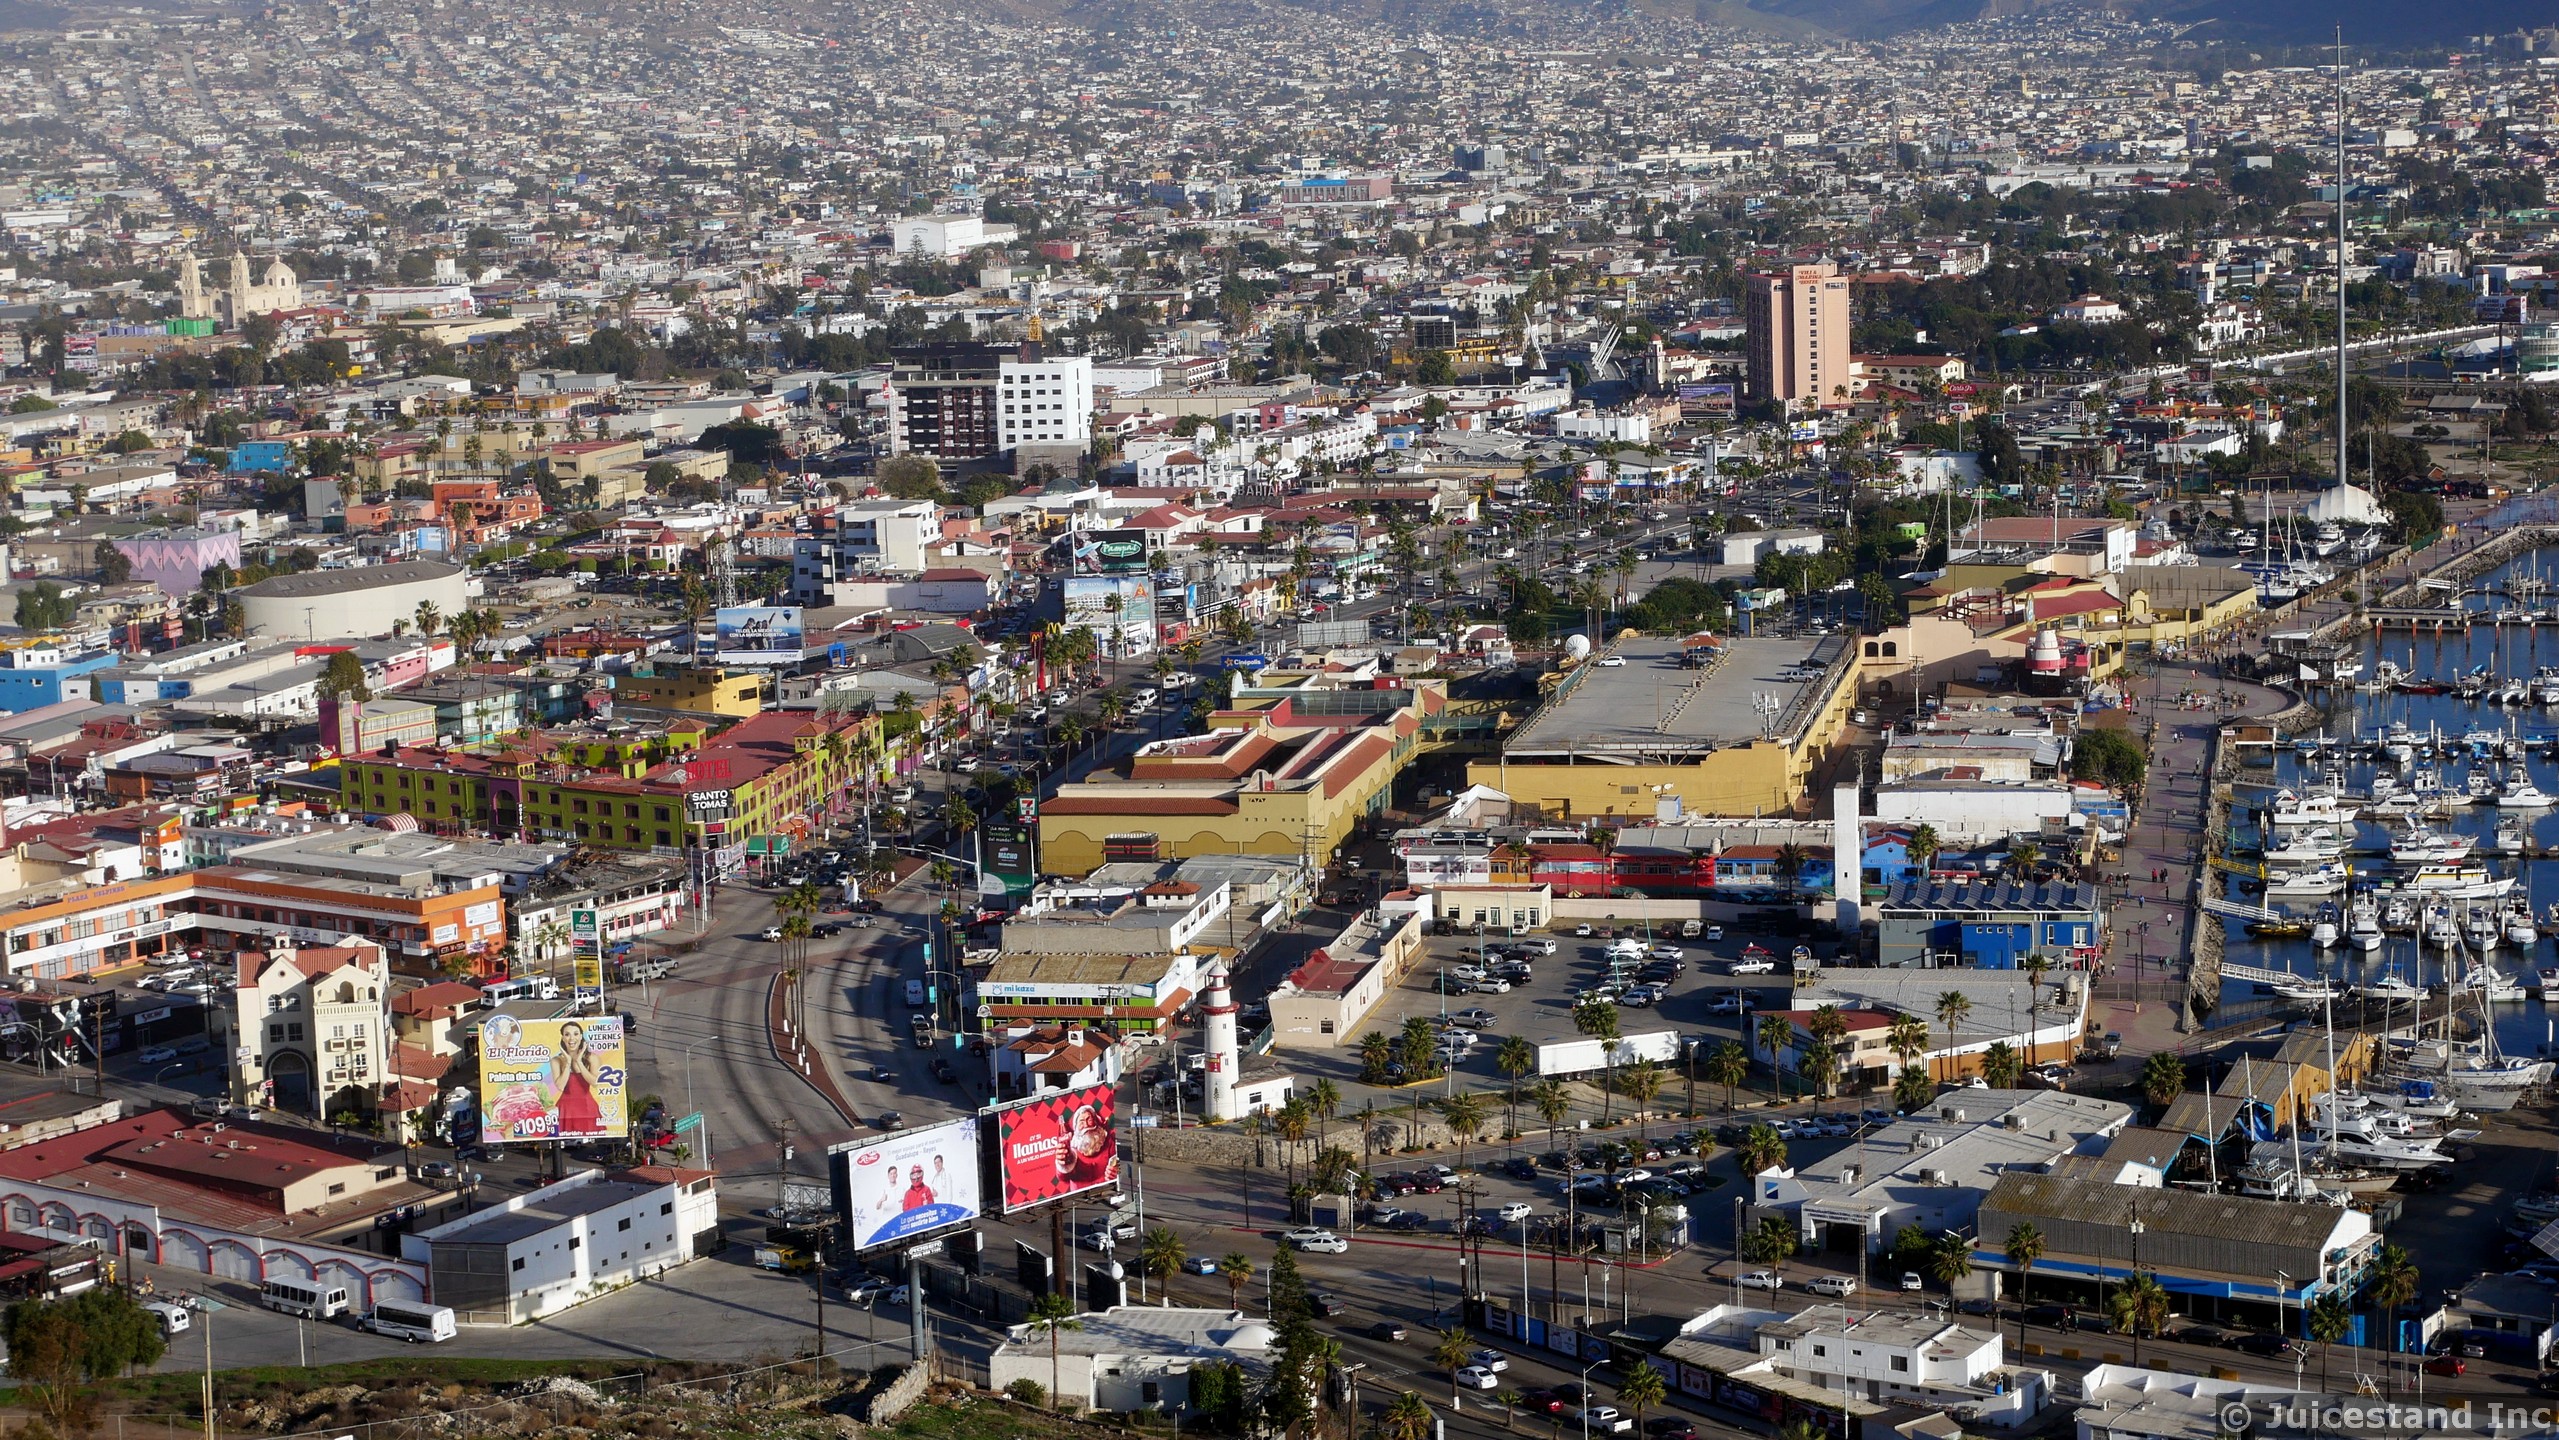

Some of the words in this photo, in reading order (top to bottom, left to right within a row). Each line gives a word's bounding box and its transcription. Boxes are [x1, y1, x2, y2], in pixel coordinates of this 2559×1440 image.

[1233, 658, 1261, 667] Cinépolis
[686, 759, 734, 781] HOTEL
[692, 789, 729, 802] SANTO
[694, 799, 728, 811] TOMAS
[1014, 985, 1036, 993] kaza
[587, 1023, 612, 1032] LUNES
[614, 1023, 621, 1031] A
[588, 1032, 622, 1042] VIERNES
[487, 1048, 501, 1059] El
[505, 1046, 549, 1058] Florido
[488, 1072, 515, 1083] Paleta
[515, 1072, 527, 1082] de
[528, 1072, 543, 1081] res
[597, 1065, 624, 1087] 23
[598, 1087, 620, 1096] XHS
[513, 1116, 546, 1135] $109
[546, 1124, 556, 1134] kg
[895, 1150, 919, 1161] Guadalupe
[922, 1145, 937, 1154] Reyes
[1013, 1136, 1058, 1159] llamas
[915, 1209, 938, 1220] necesitas
[899, 1223, 911, 1232] para
[928, 1215, 939, 1224] bien
